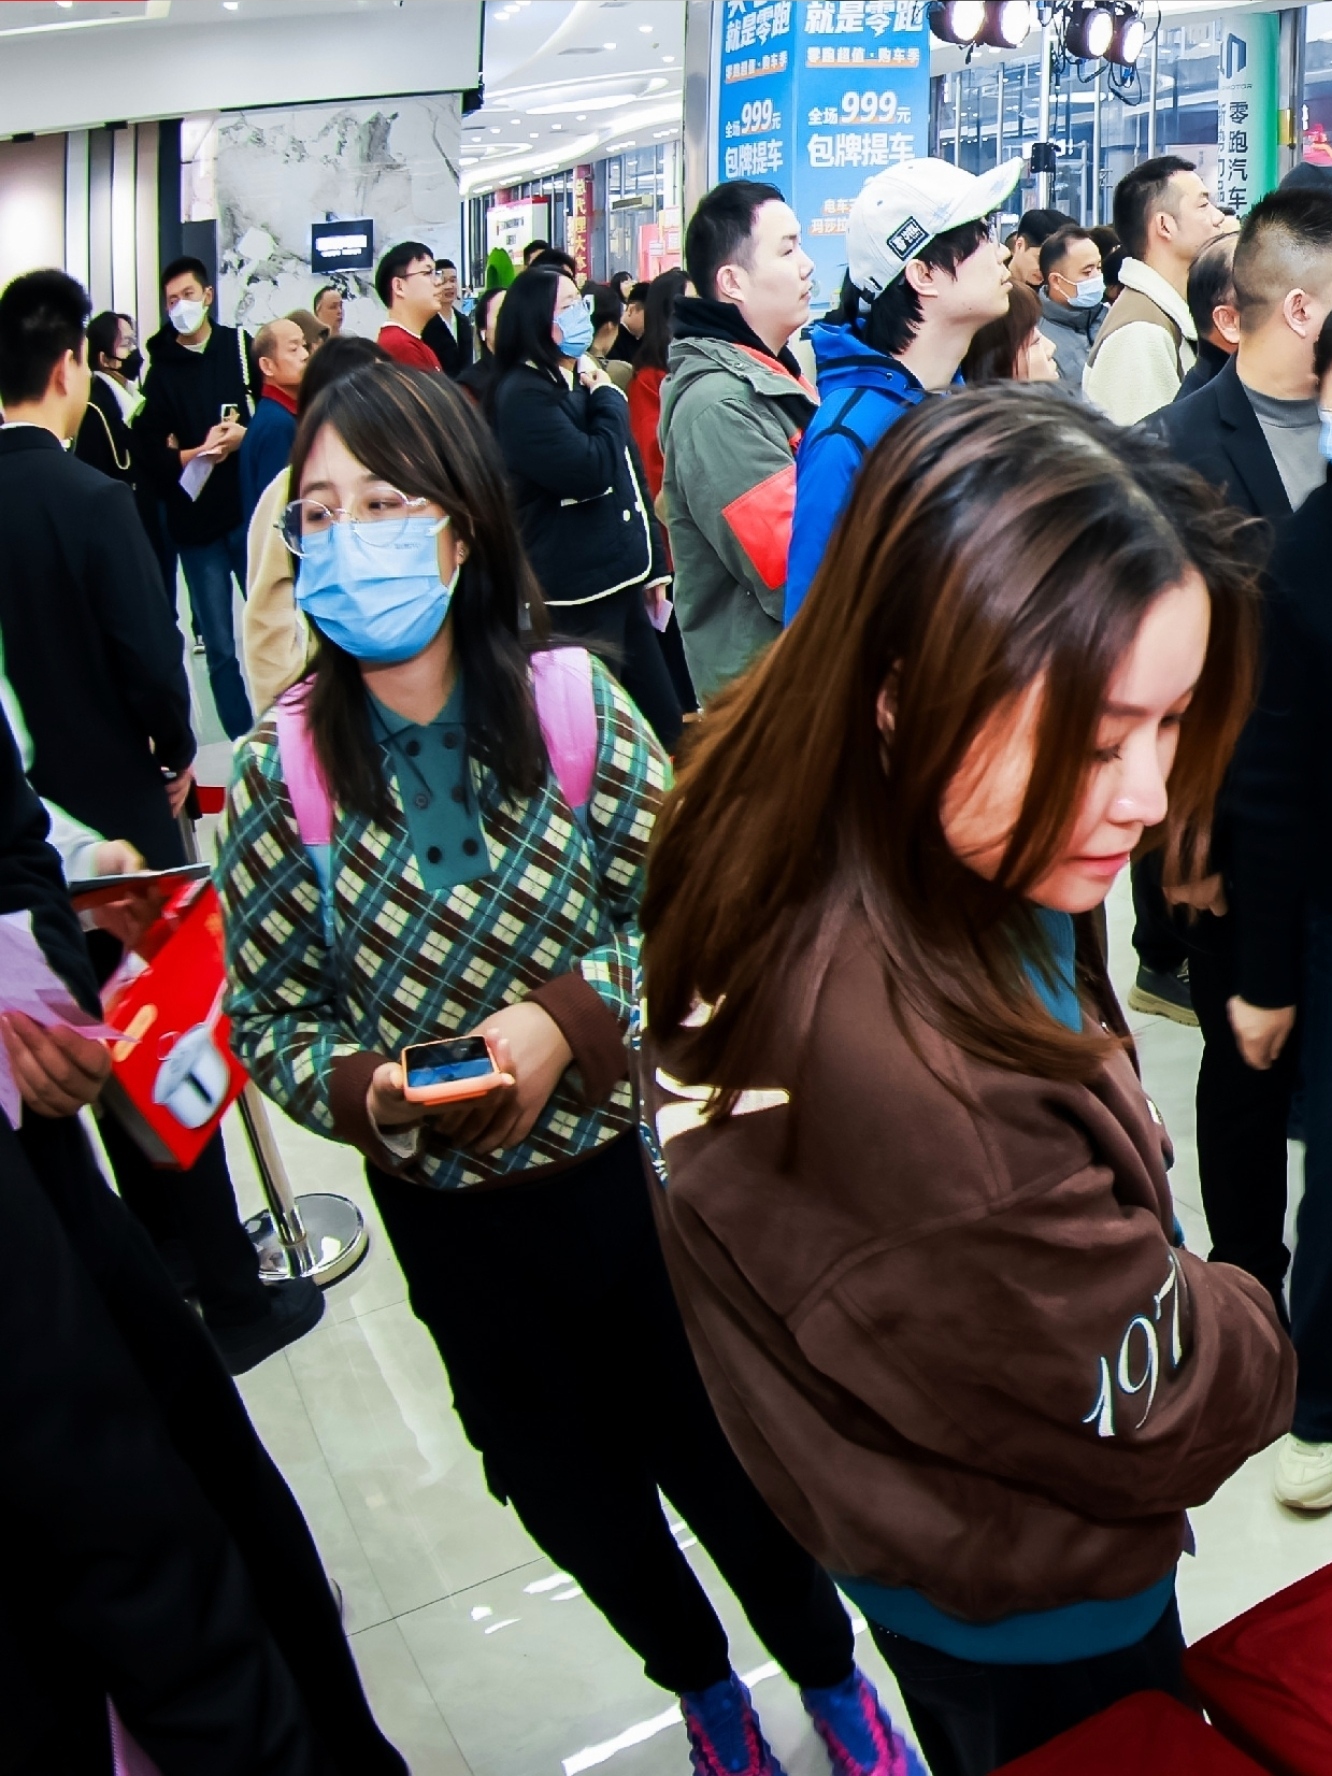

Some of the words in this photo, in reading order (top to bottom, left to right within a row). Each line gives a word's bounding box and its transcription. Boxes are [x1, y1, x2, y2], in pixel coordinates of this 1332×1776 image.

[725, 1, 791, 54] 就是零跑
[804, 1, 926, 38] 就是零跑
[808, 91, 912, 126] 全场999元
[725, 138, 784, 179] 包牌提车
[807, 132, 916, 168] 包牌提车
[1228, 101, 1249, 210] 零跑汽车
